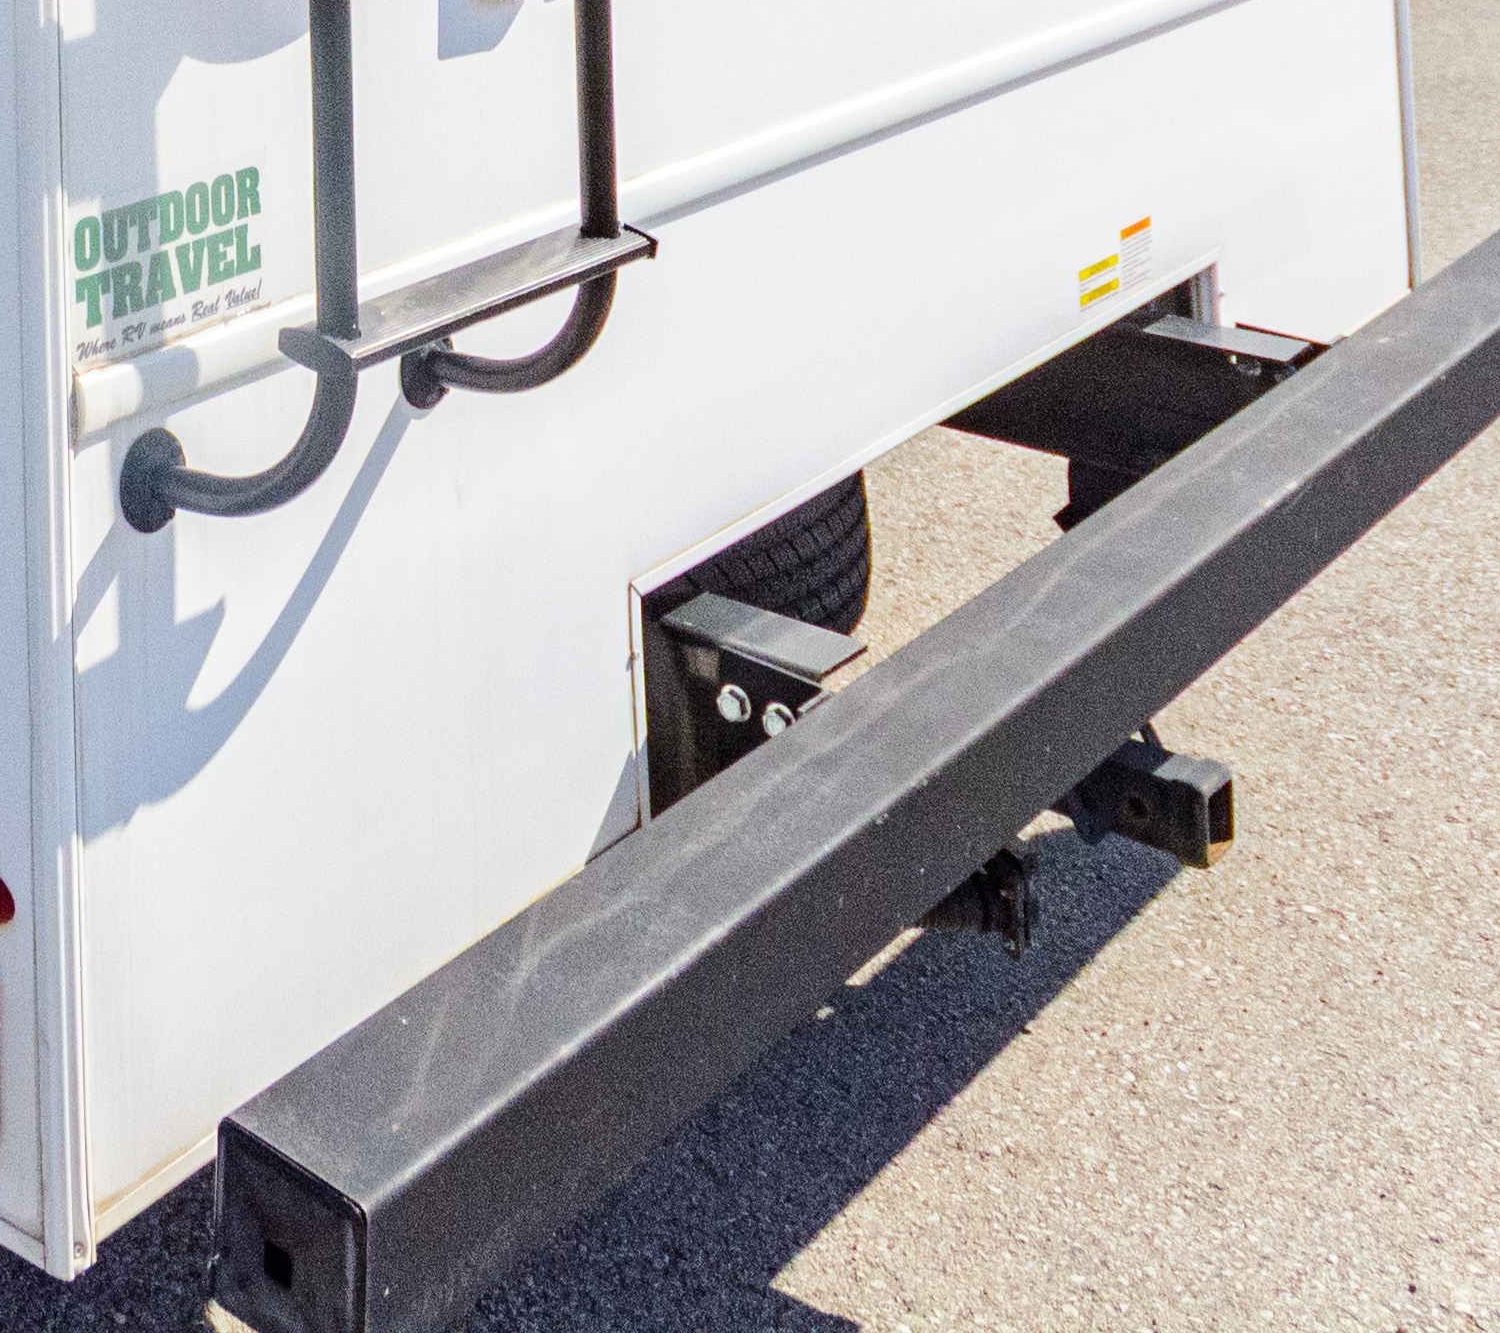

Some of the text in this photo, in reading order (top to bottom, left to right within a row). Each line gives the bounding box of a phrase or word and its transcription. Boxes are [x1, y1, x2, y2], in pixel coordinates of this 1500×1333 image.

[74, 166, 261, 272] OUTDOOR
[75, 224, 261, 329] TRAVEL
[76, 279, 262, 361] Where RV means Real Value!
